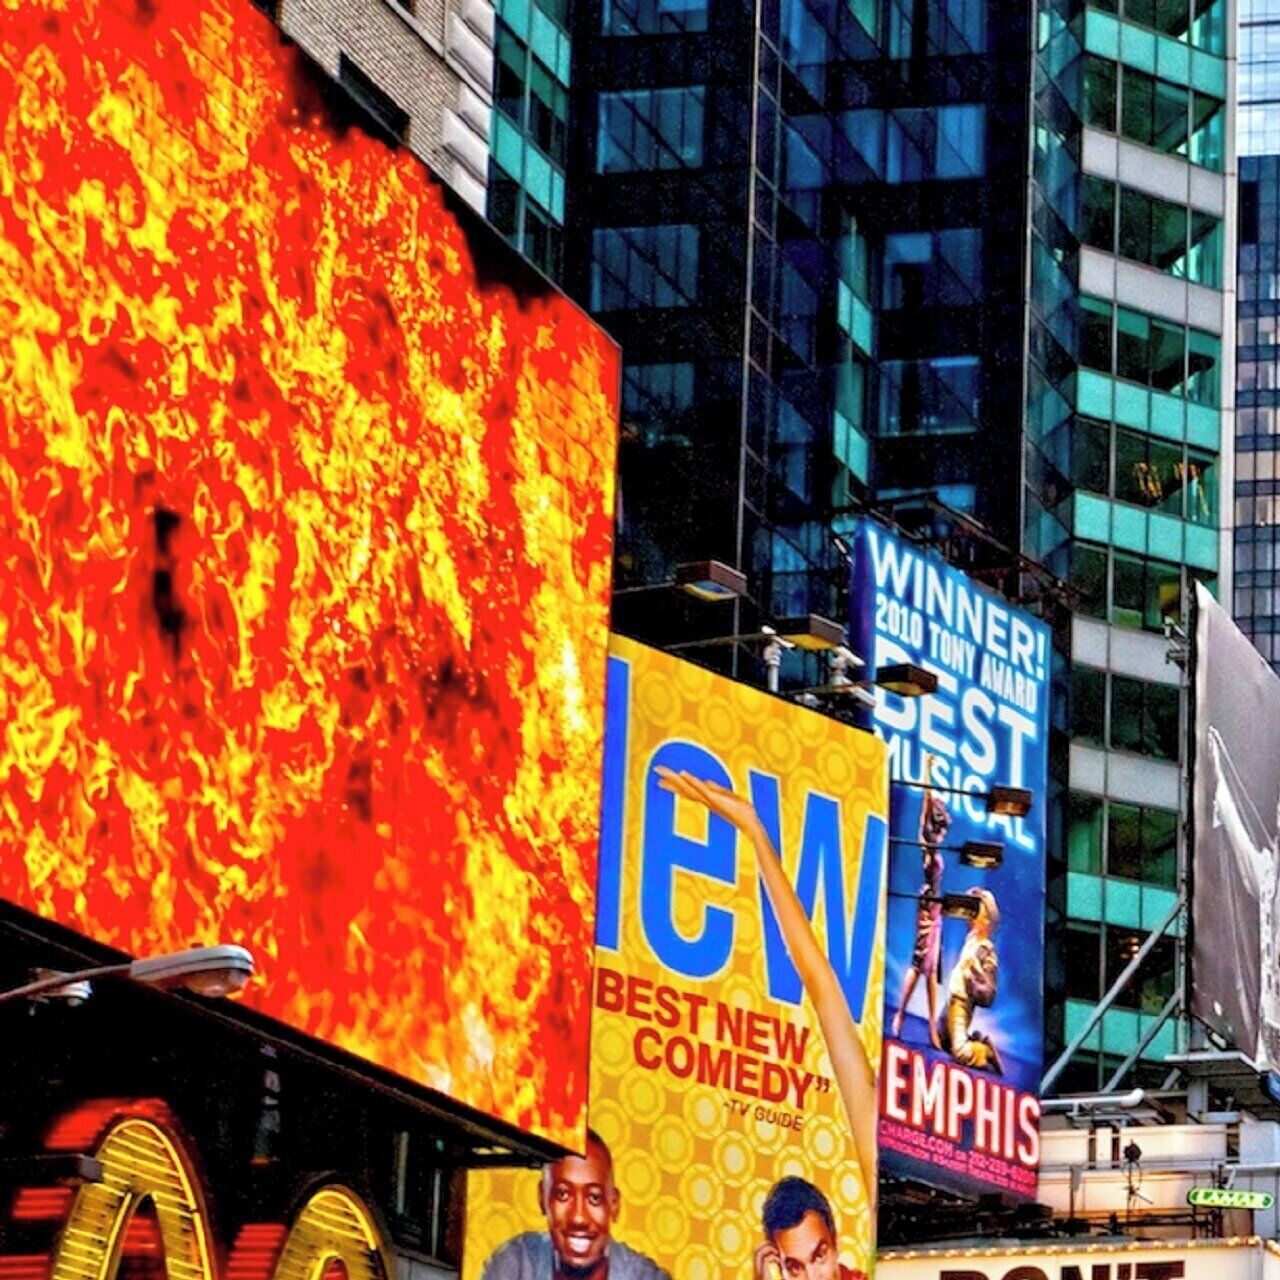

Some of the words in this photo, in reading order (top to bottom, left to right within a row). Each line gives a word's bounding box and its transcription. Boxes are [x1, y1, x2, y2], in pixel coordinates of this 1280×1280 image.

[869, 529, 1045, 680] WINNER!
[875, 597, 924, 648] 2010
[928, 623, 977, 680] TONY
[979, 656, 1038, 714] AWARD
[873, 636, 1037, 792] BEST
[873, 725, 1036, 850] MUSICAL
[596, 968, 708, 1035] BEST
[715, 1004, 810, 1064] NEW
[754, 1104, 804, 1132] GUIDE
[886, 1043, 1041, 1166] EMPHIS
